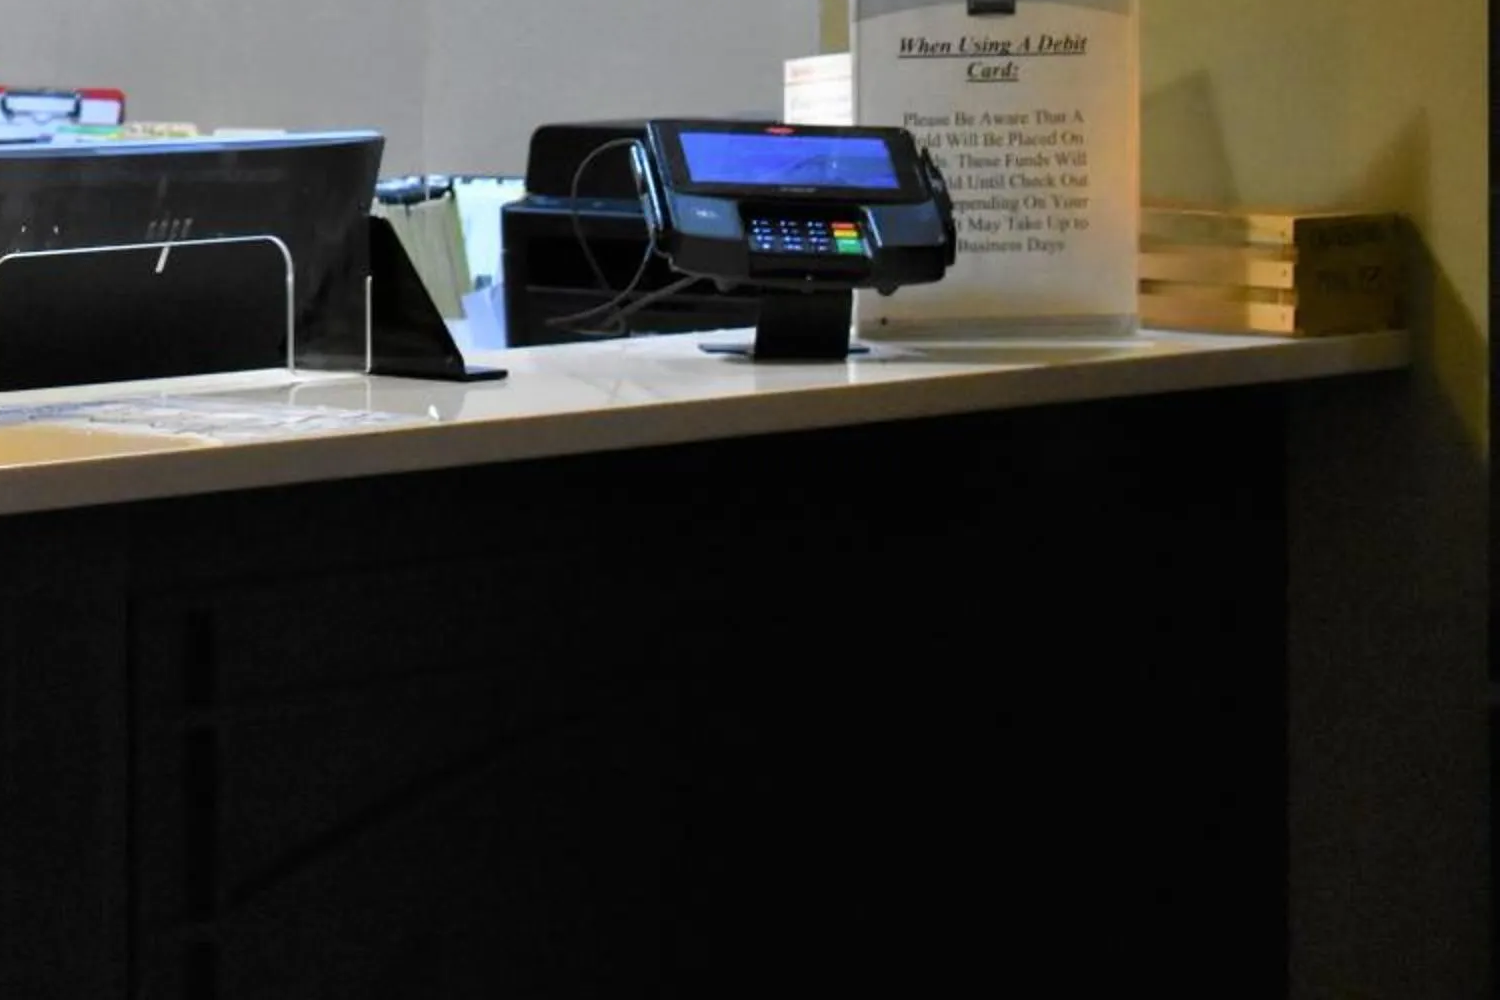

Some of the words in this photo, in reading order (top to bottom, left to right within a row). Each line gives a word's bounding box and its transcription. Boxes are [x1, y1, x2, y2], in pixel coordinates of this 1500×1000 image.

[900, 36, 952, 54] When
[958, 36, 1012, 56] Using
[1015, 34, 1031, 52] A
[1037, 34, 1088, 53] Debit
[966, 60, 1020, 79] Card:
[903, 111, 950, 126] Please
[955, 110, 976, 126] Be
[980, 110, 1029, 125] Aware
[1035, 108, 1067, 124] That
[1072, 108, 1085, 124] A
[916, 132, 941, 147] old
[946, 132, 980, 147] Will
[983, 132, 1004, 147] Be
[1008, 130, 1057, 146] Placed
[1060, 130, 1084, 145] On
[1004, 152, 1050, 168] Funds
[1054, 151, 1088, 166] Will
[967, 174, 1005, 189] Until
[1009, 173, 1056, 188] Check
[1060, 173, 1088, 187] Out
[1023, 196, 1047, 209] On
[1051, 194, 1090, 209] Your
[967, 216, 1001, 233] May
[1007, 215, 1042, 231] Take
[1046, 214, 1070, 232] Up
[1073, 217, 1090, 231] to
[957, 237, 1022, 252] Business
